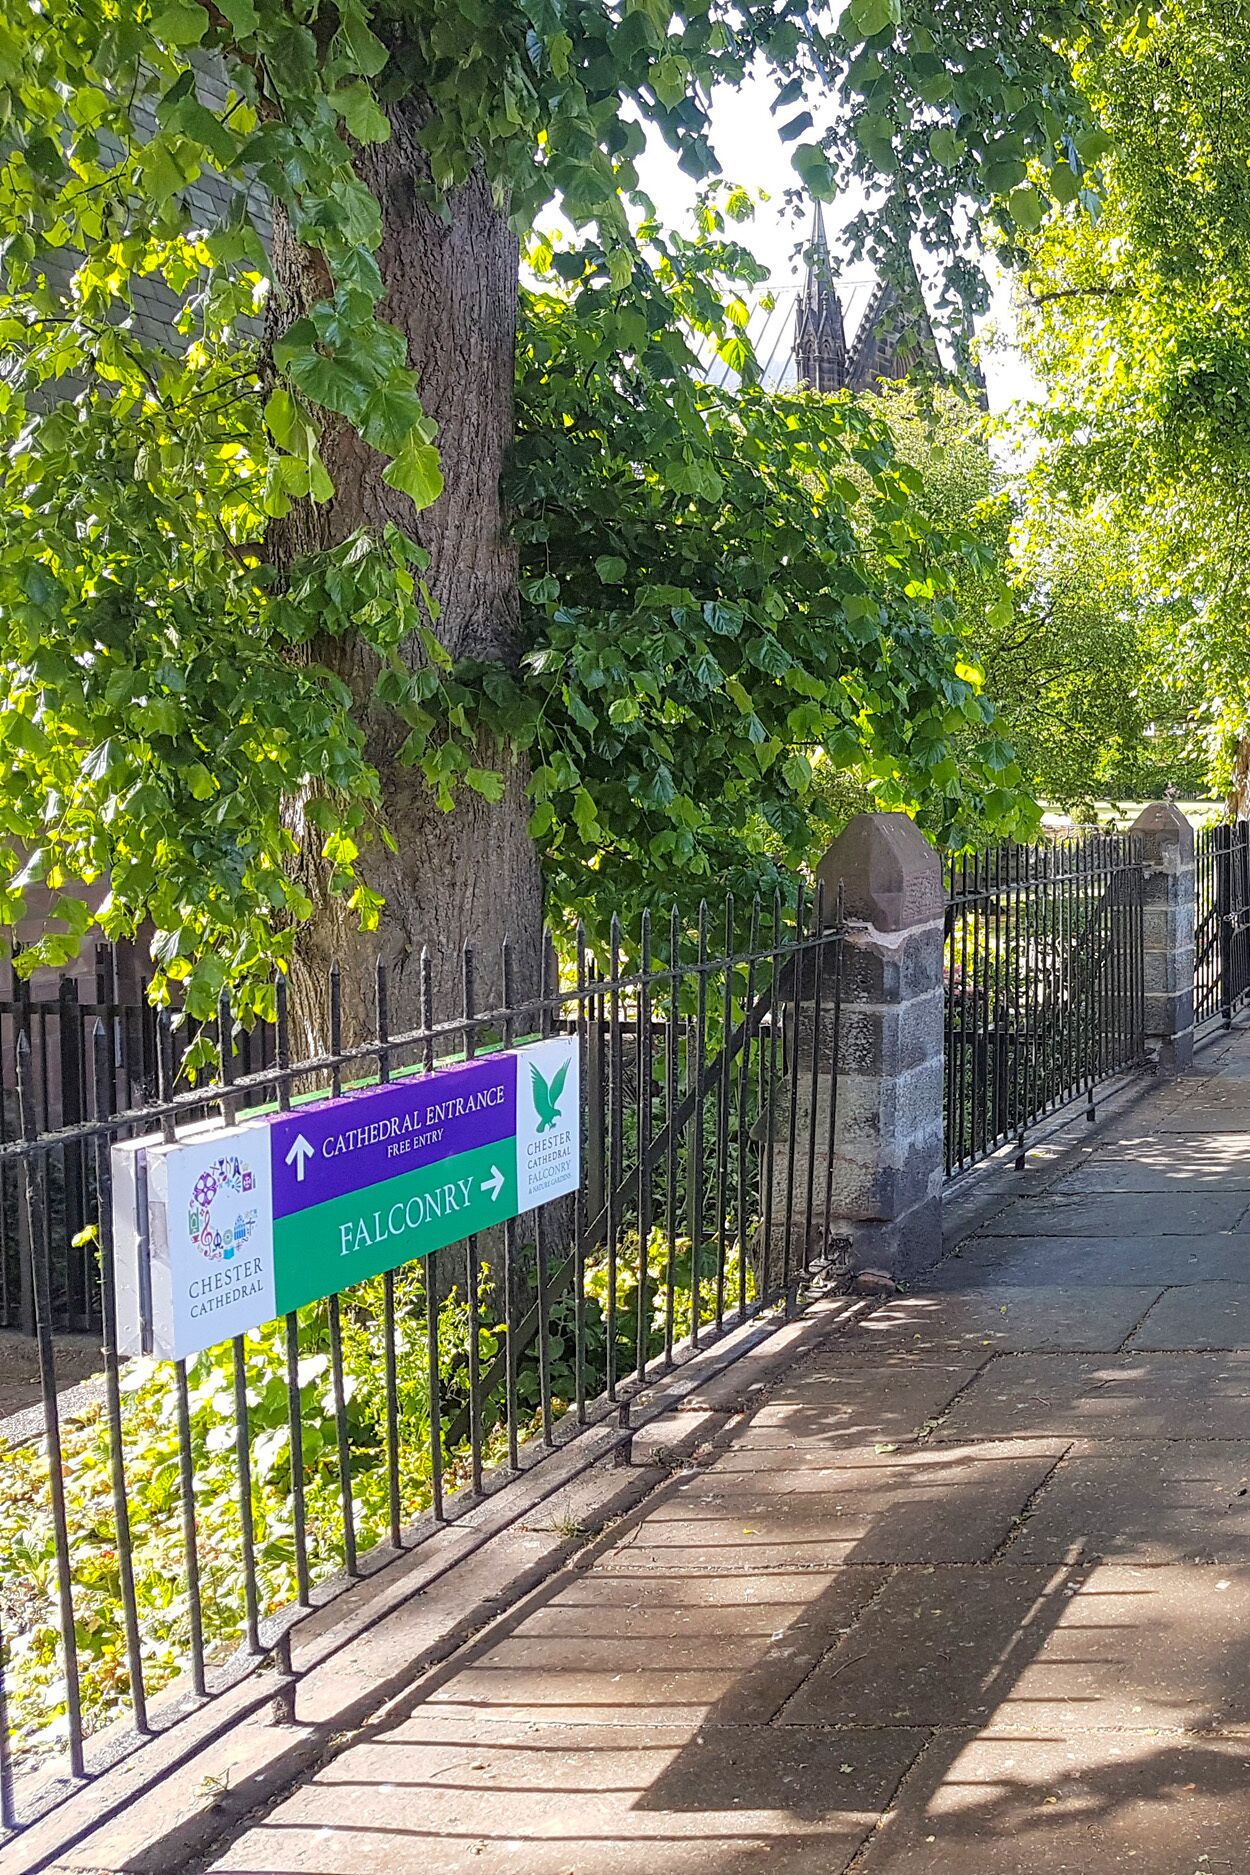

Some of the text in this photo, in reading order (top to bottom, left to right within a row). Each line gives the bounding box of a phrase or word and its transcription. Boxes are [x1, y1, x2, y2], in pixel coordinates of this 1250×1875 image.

[322, 1085, 505, 1158] CATHEDRAL ENTRANCE
[387, 1128, 444, 1158] FREE ENTRY
[527, 1130, 571, 1156] CHESTER
[527, 1146, 571, 1170] CATHEDRAL
[528, 1160, 571, 1185] FALCONRY
[338, 1176, 475, 1256] FALCONRY
[188, 1257, 263, 1299] CHESTER
[190, 1279, 264, 1318] CATHEDRAL
